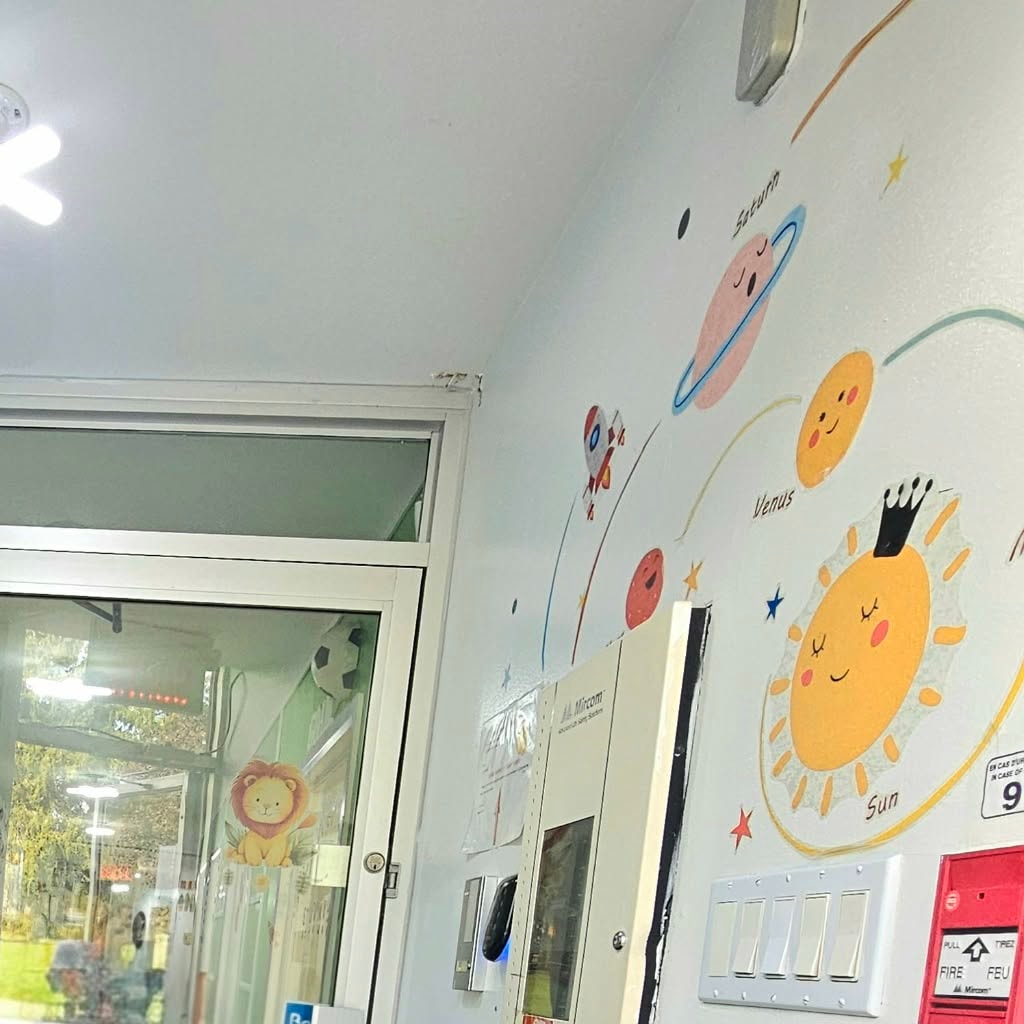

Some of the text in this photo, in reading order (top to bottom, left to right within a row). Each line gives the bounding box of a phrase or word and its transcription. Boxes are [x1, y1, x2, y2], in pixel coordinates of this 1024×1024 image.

[732, 171, 780, 240] Saturn
[752, 490, 795, 519] Venus
[574, 691, 603, 716] Mircom
[997, 760, 1010, 769] CAS
[997, 770, 1013, 779] CASE
[1002, 781, 1022, 811] 9
[866, 792, 899, 820] Sun
[943, 940, 1015, 949] PULL TIREZ
[939, 966, 1010, 980] FIRE FEU
[964, 985, 989, 994] Mircom
